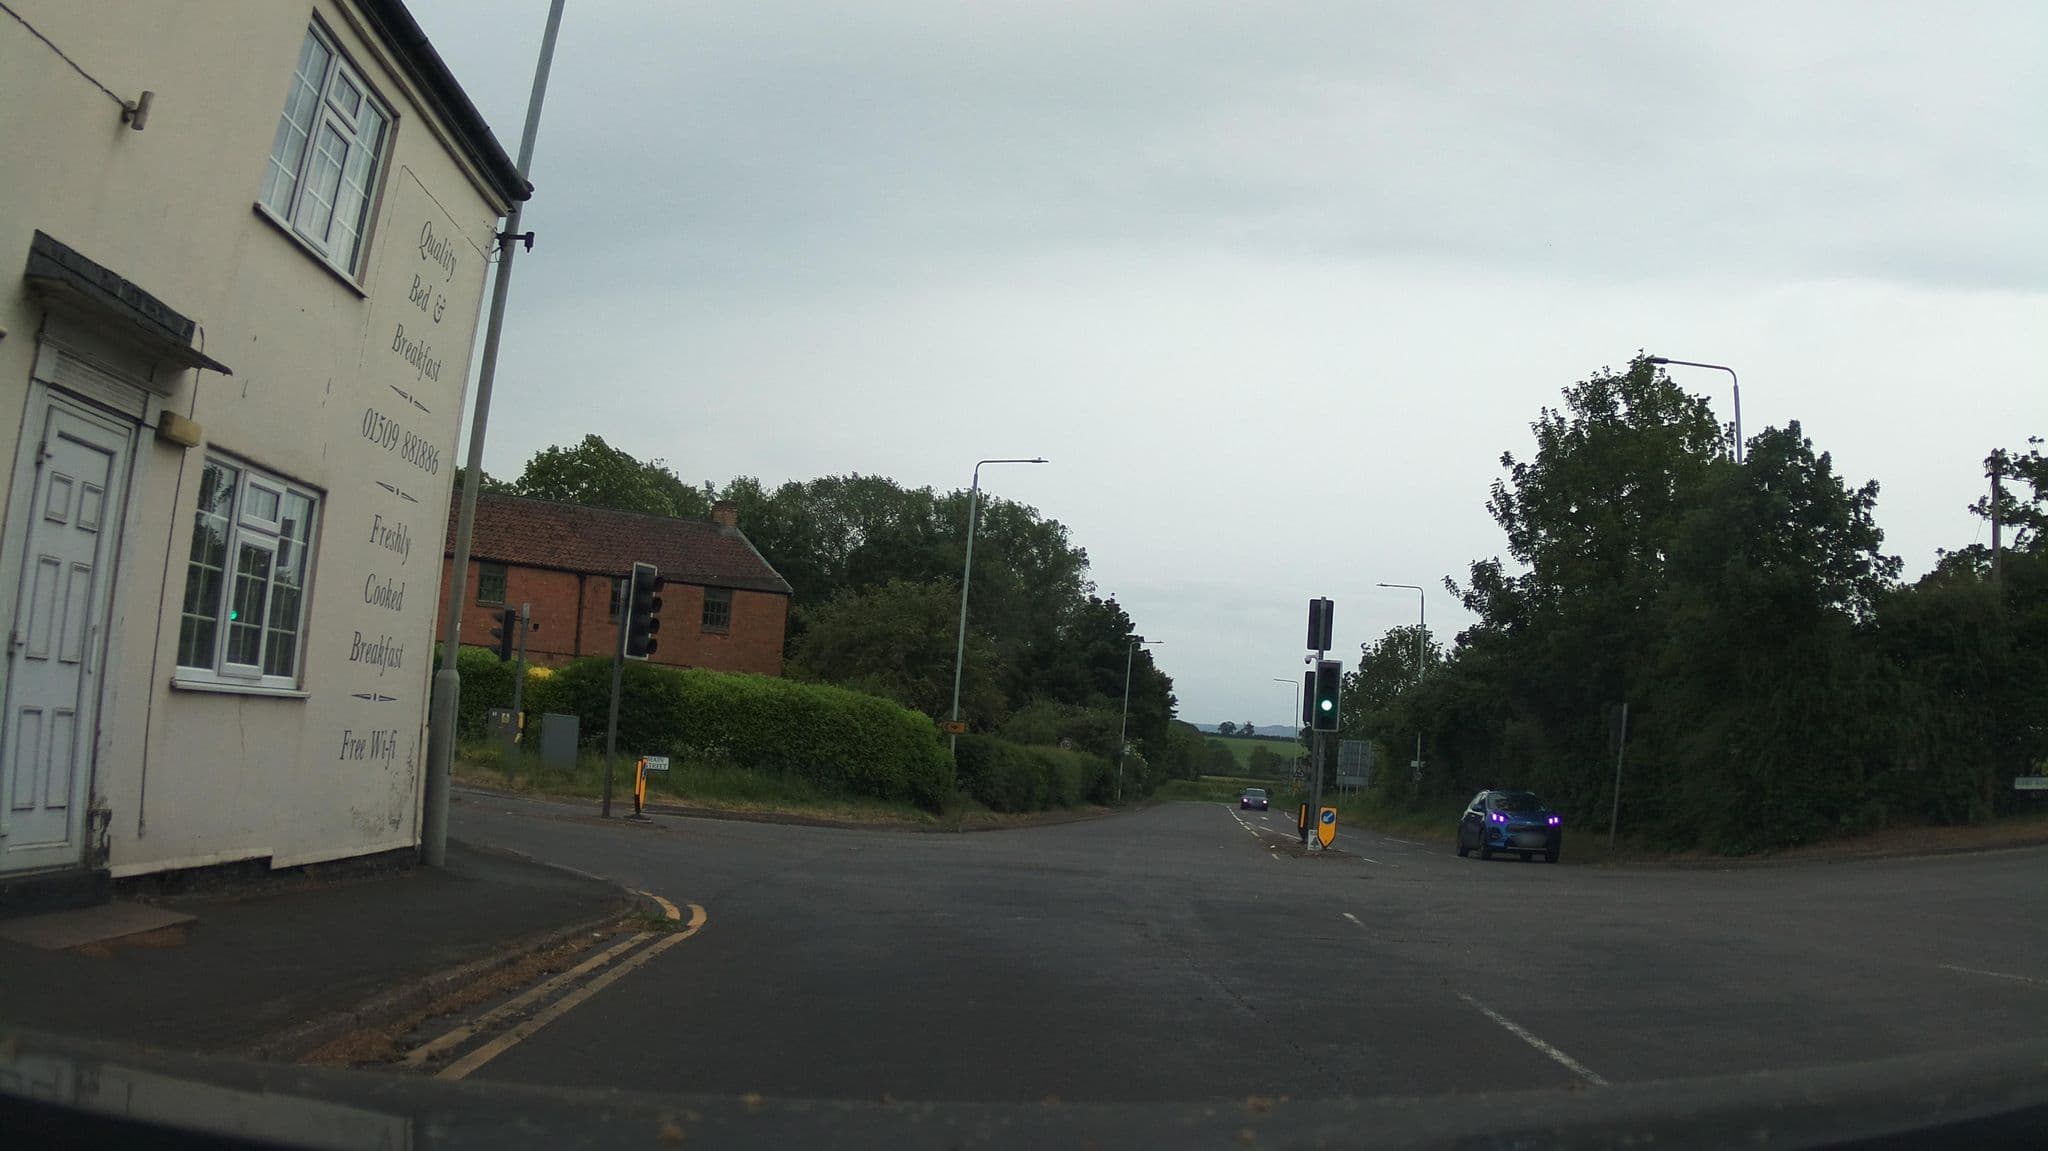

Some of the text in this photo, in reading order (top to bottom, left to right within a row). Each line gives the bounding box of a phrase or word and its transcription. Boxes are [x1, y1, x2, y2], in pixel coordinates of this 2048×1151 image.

[418, 220, 457, 282] Quality
[408, 273, 446, 324] Bed &
[391, 323, 442, 382] Breakfast
[362, 407, 440, 475] 01509 881886
[369, 513, 411, 565] Freshly
[364, 573, 406, 612] Cooked
[349, 631, 404, 677] Breakfast
[339, 729, 367, 761] Free
